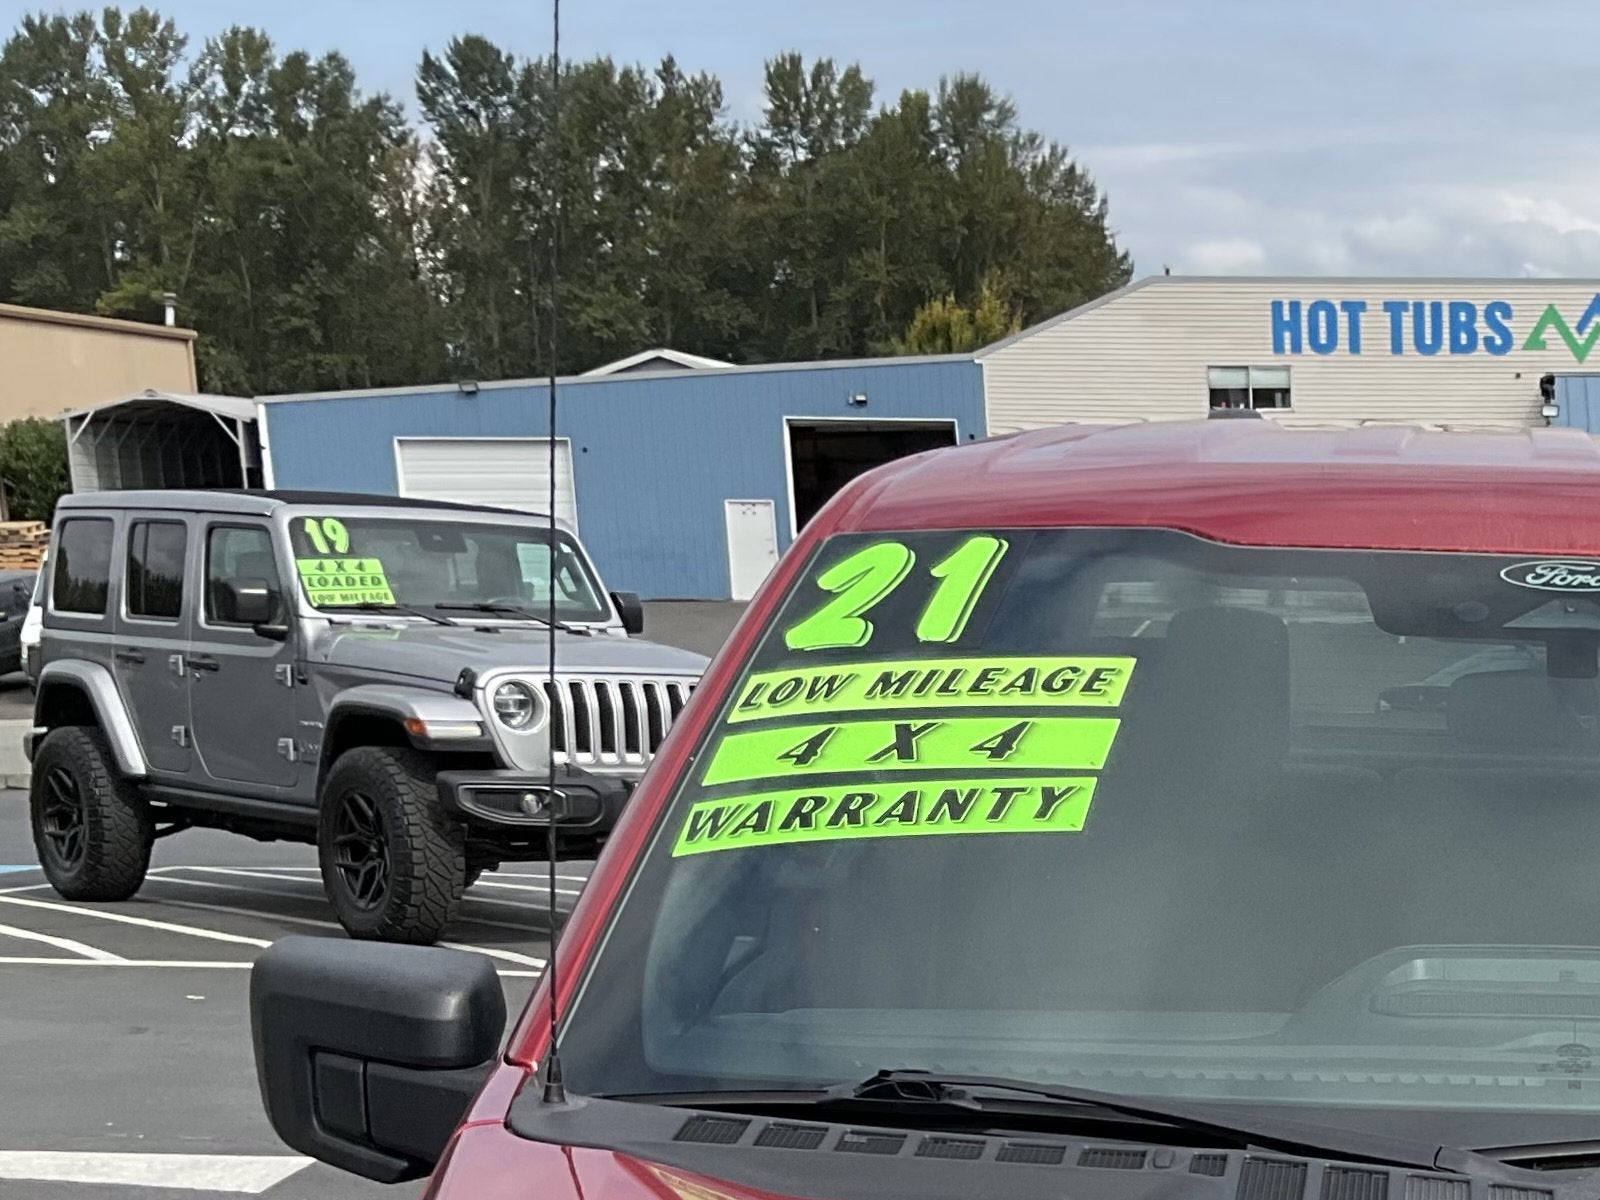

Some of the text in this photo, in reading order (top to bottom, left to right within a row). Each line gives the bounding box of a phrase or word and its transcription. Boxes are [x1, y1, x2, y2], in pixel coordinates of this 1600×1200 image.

[1271, 300, 1367, 354] HOT
[1383, 300, 1514, 355] TUBS
[304, 517, 350, 554] 19
[307, 575, 383, 588] LOADED
[784, 536, 1010, 651] 21
[737, 664, 1123, 713] LOW MILEAGE
[776, 719, 1037, 768] 4 X 4
[683, 783, 1083, 845] WARRANTY
